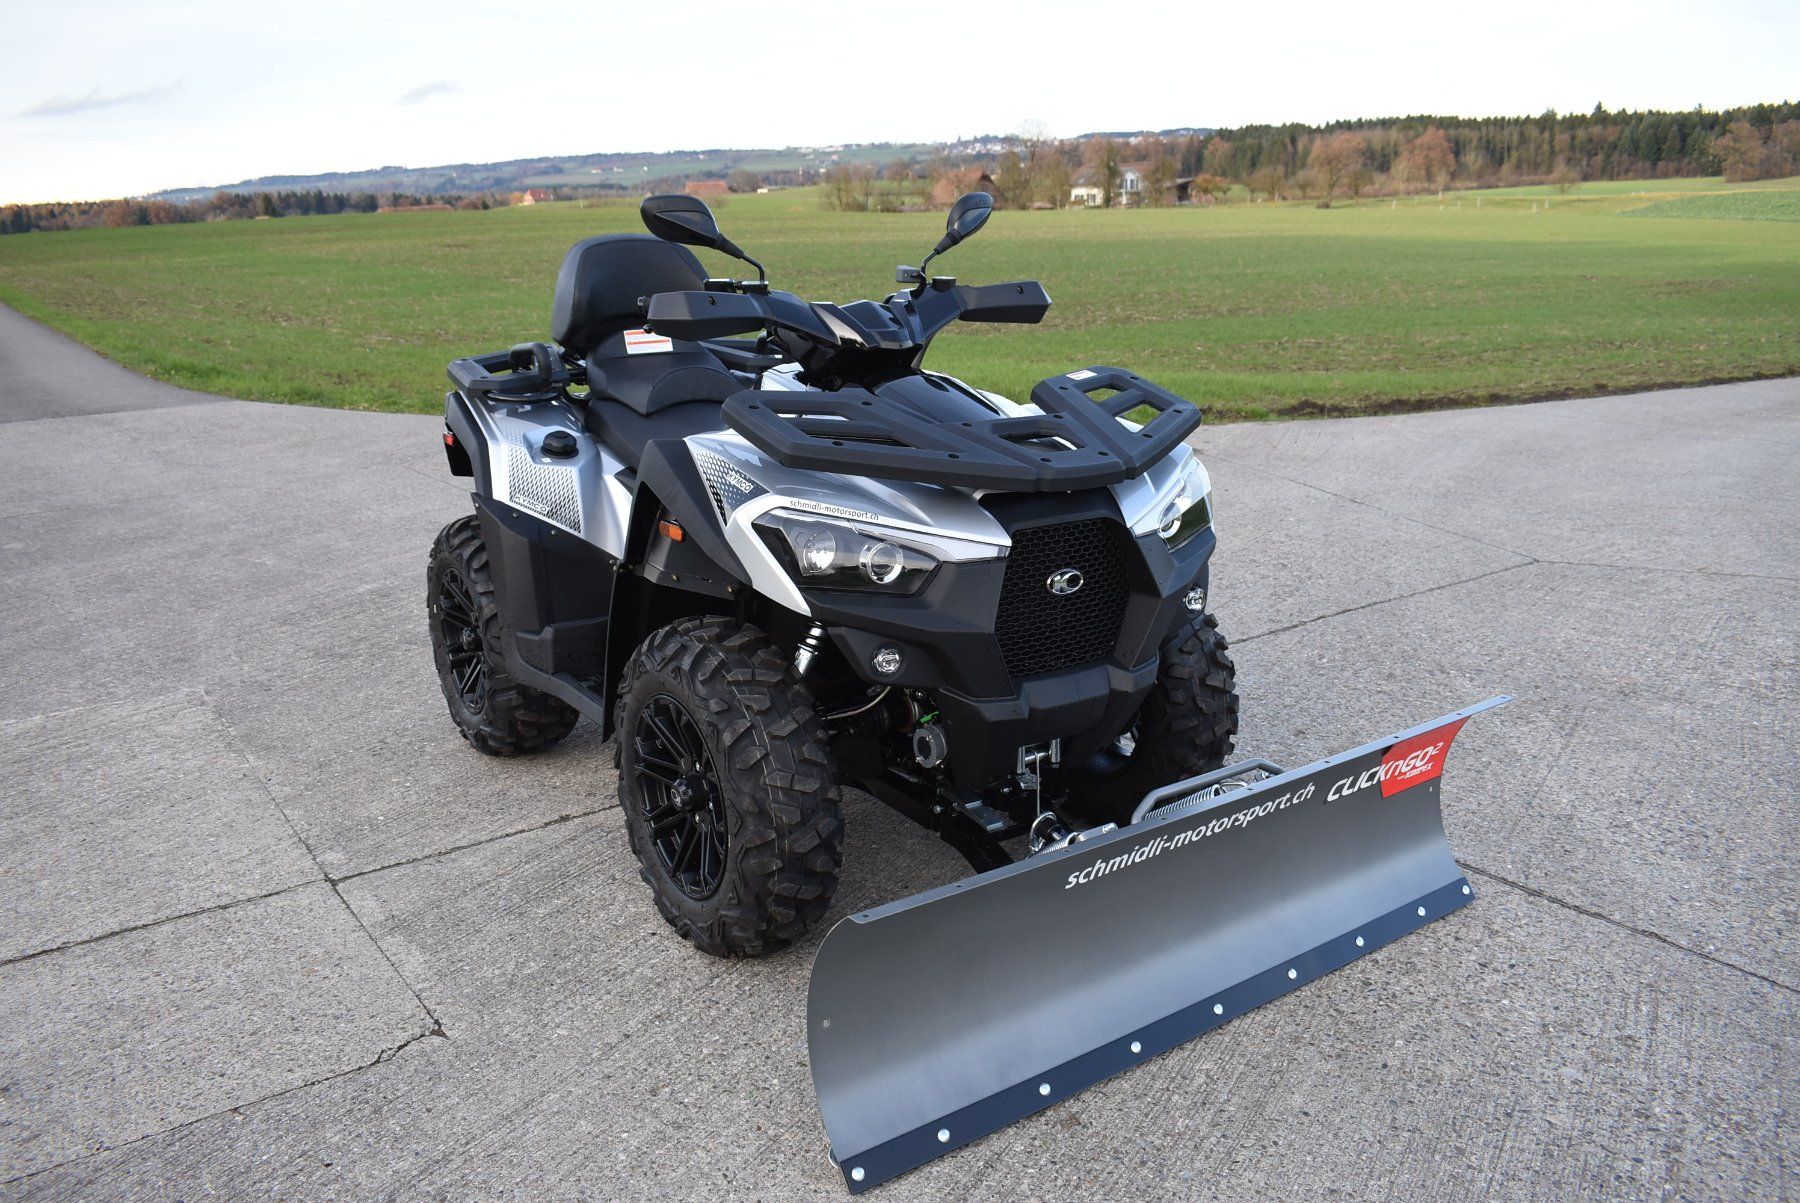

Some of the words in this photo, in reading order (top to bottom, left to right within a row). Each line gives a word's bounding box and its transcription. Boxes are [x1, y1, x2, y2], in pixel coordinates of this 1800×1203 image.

[728, 473, 752, 492] KYMCO
[512, 496, 547, 512] KYMCO
[789, 500, 879, 521] schmidli-motorsport.ch
[1065, 782, 1316, 889] schmidli-motorsport.ch
